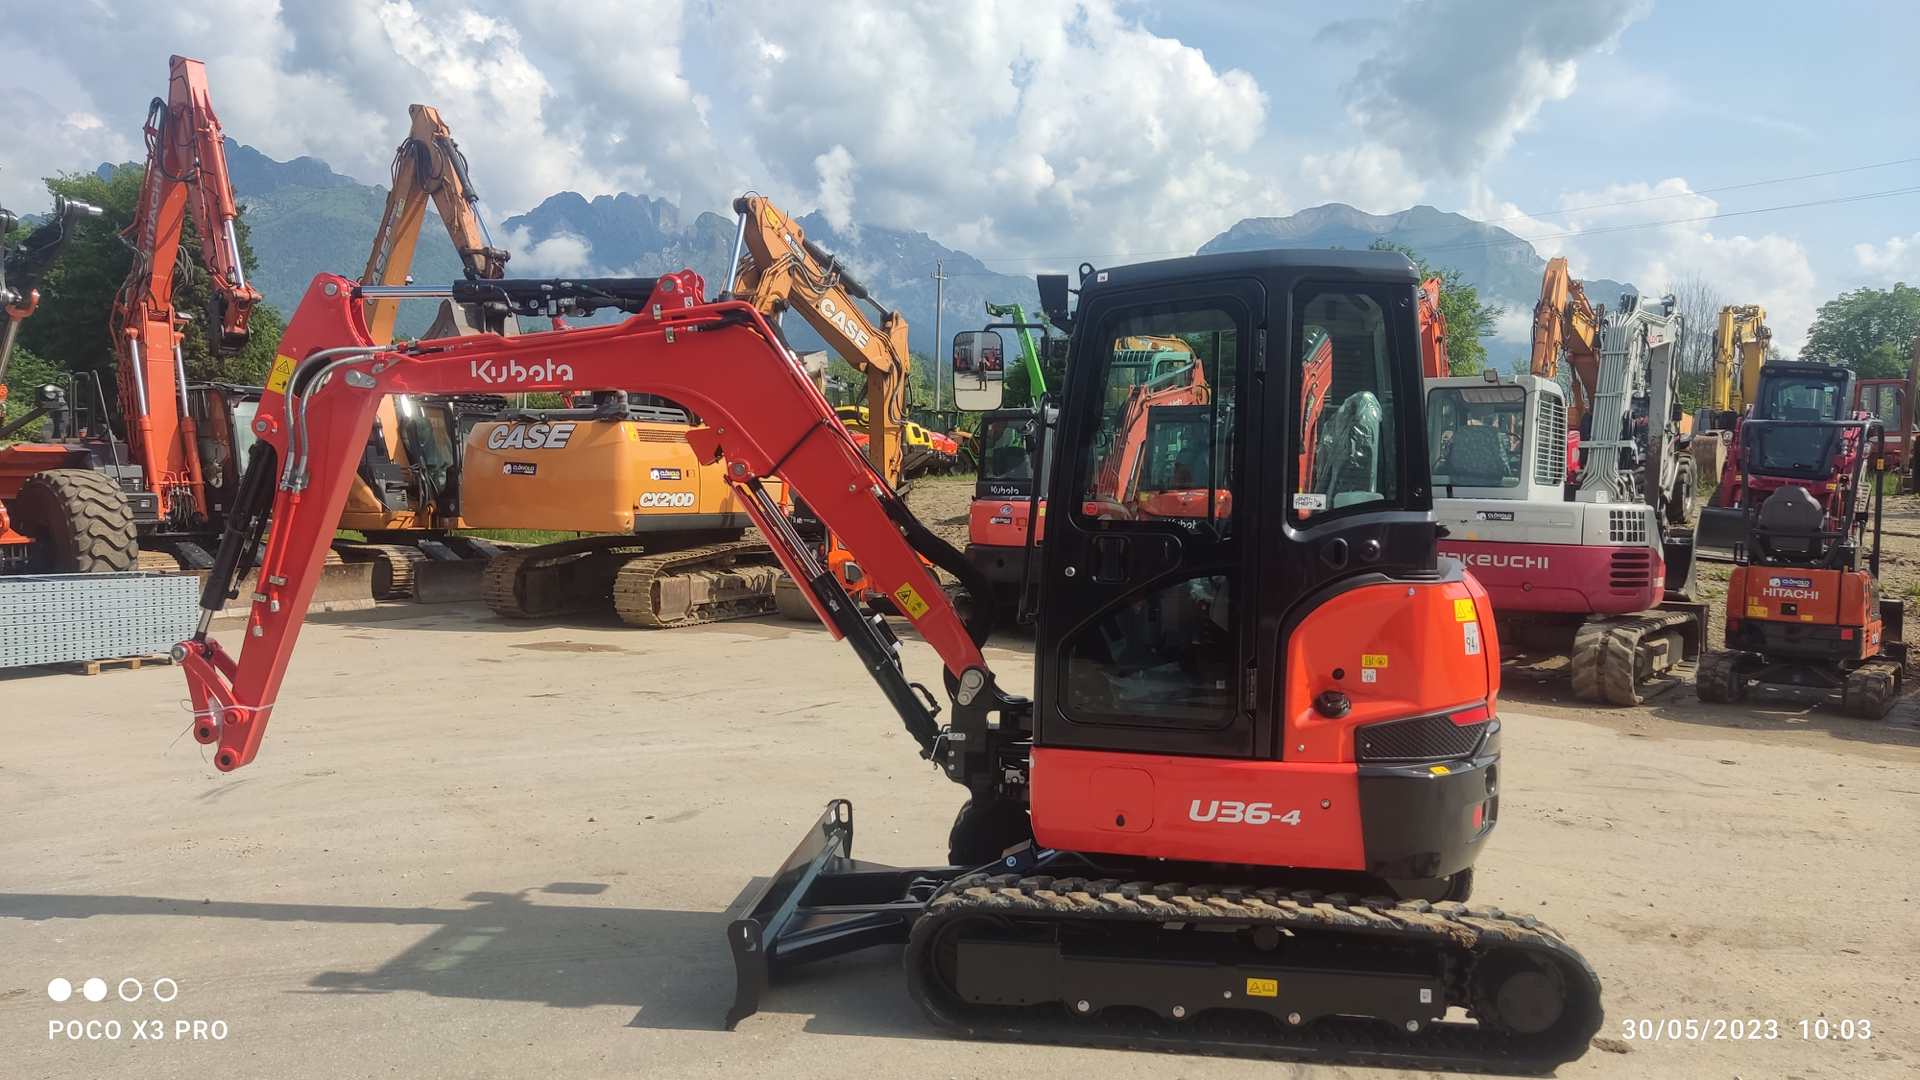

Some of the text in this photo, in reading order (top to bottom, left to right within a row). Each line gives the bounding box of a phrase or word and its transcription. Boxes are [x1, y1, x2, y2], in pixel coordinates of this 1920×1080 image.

[143, 170, 163, 257] HITACHI
[820, 298, 870, 349] CASE
[470, 358, 573, 384] Kubota
[487, 423, 578, 450] CASE
[639, 491, 696, 508] CX210D
[990, 485, 1020, 495] Kubota
[1763, 587, 1820, 600] HITACHI
[1188, 799, 1301, 826] U36-4
